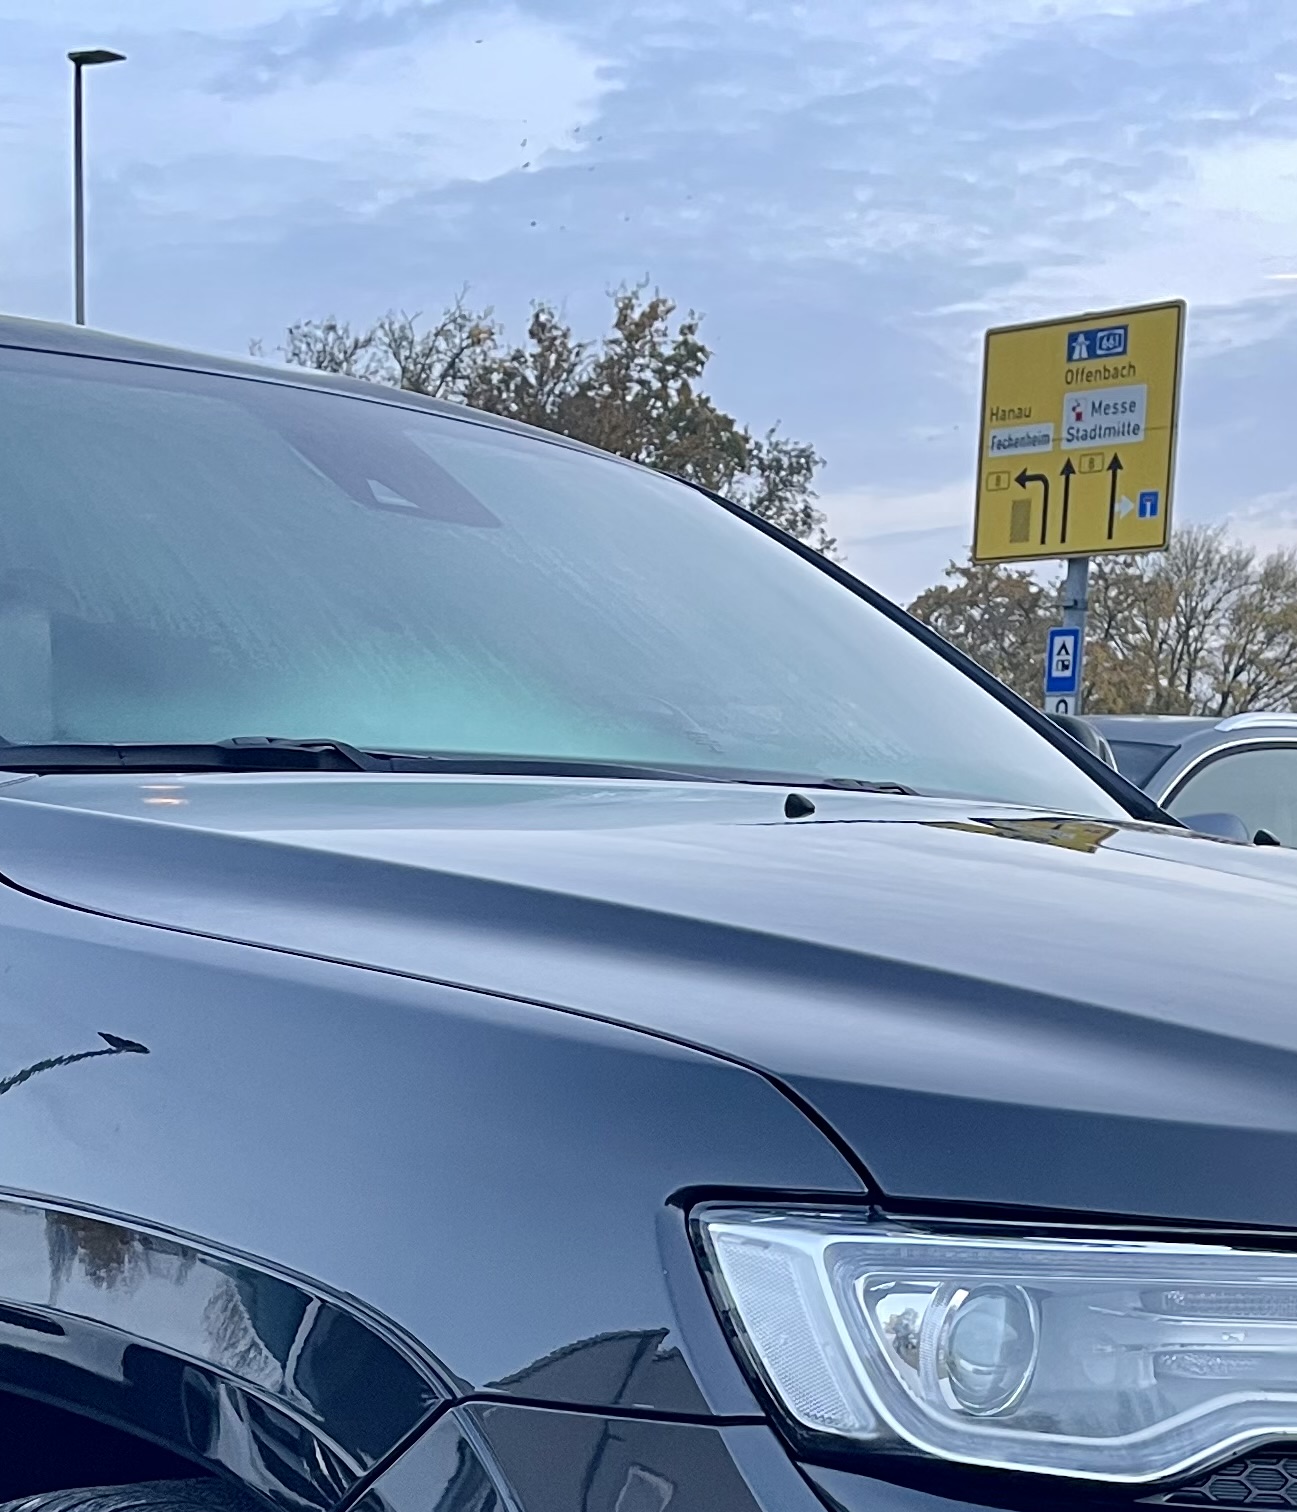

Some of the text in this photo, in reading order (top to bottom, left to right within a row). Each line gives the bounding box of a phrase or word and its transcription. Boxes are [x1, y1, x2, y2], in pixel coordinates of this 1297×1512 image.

[1065, 361, 1136, 385] Offenbach
[990, 405, 1032, 422] Hanau
[1091, 399, 1136, 417] Messe
[1066, 420, 1140, 443] Stadtmitte
